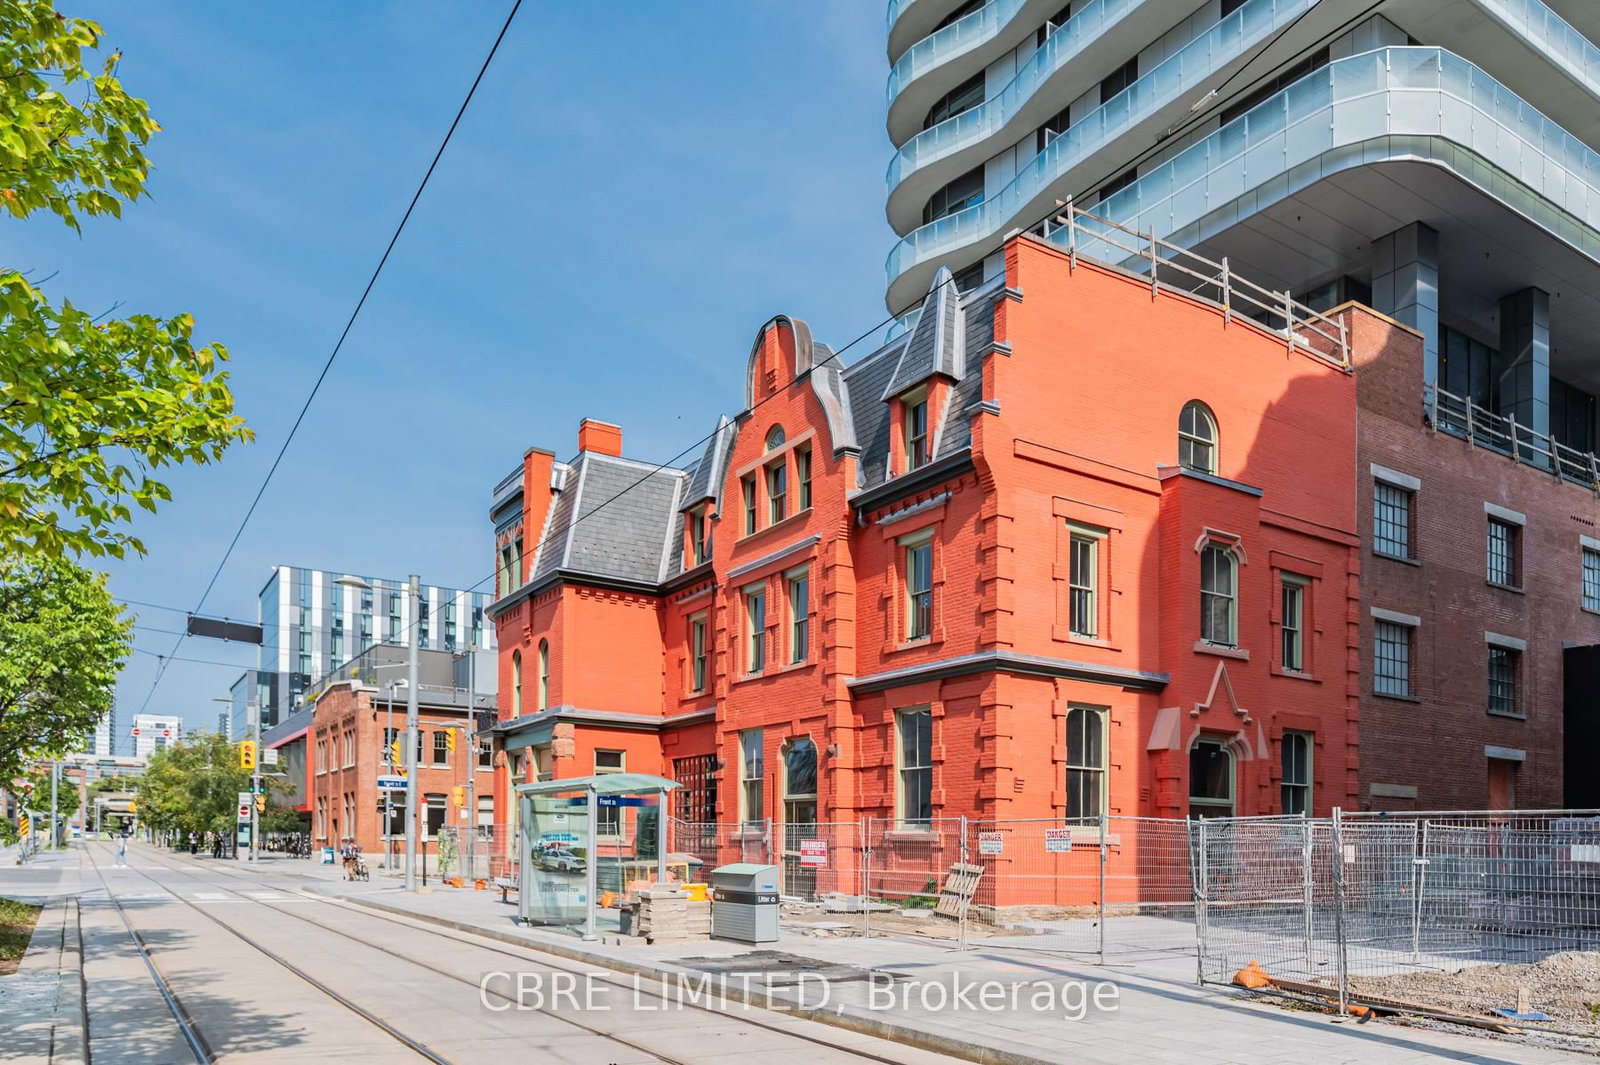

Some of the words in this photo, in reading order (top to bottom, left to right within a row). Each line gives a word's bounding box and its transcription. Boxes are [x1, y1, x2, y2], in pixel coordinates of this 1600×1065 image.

[980, 833, 1002, 841] DANGER
[1046, 830, 1071, 839] DANGER
[758, 895, 770, 903] Litter
